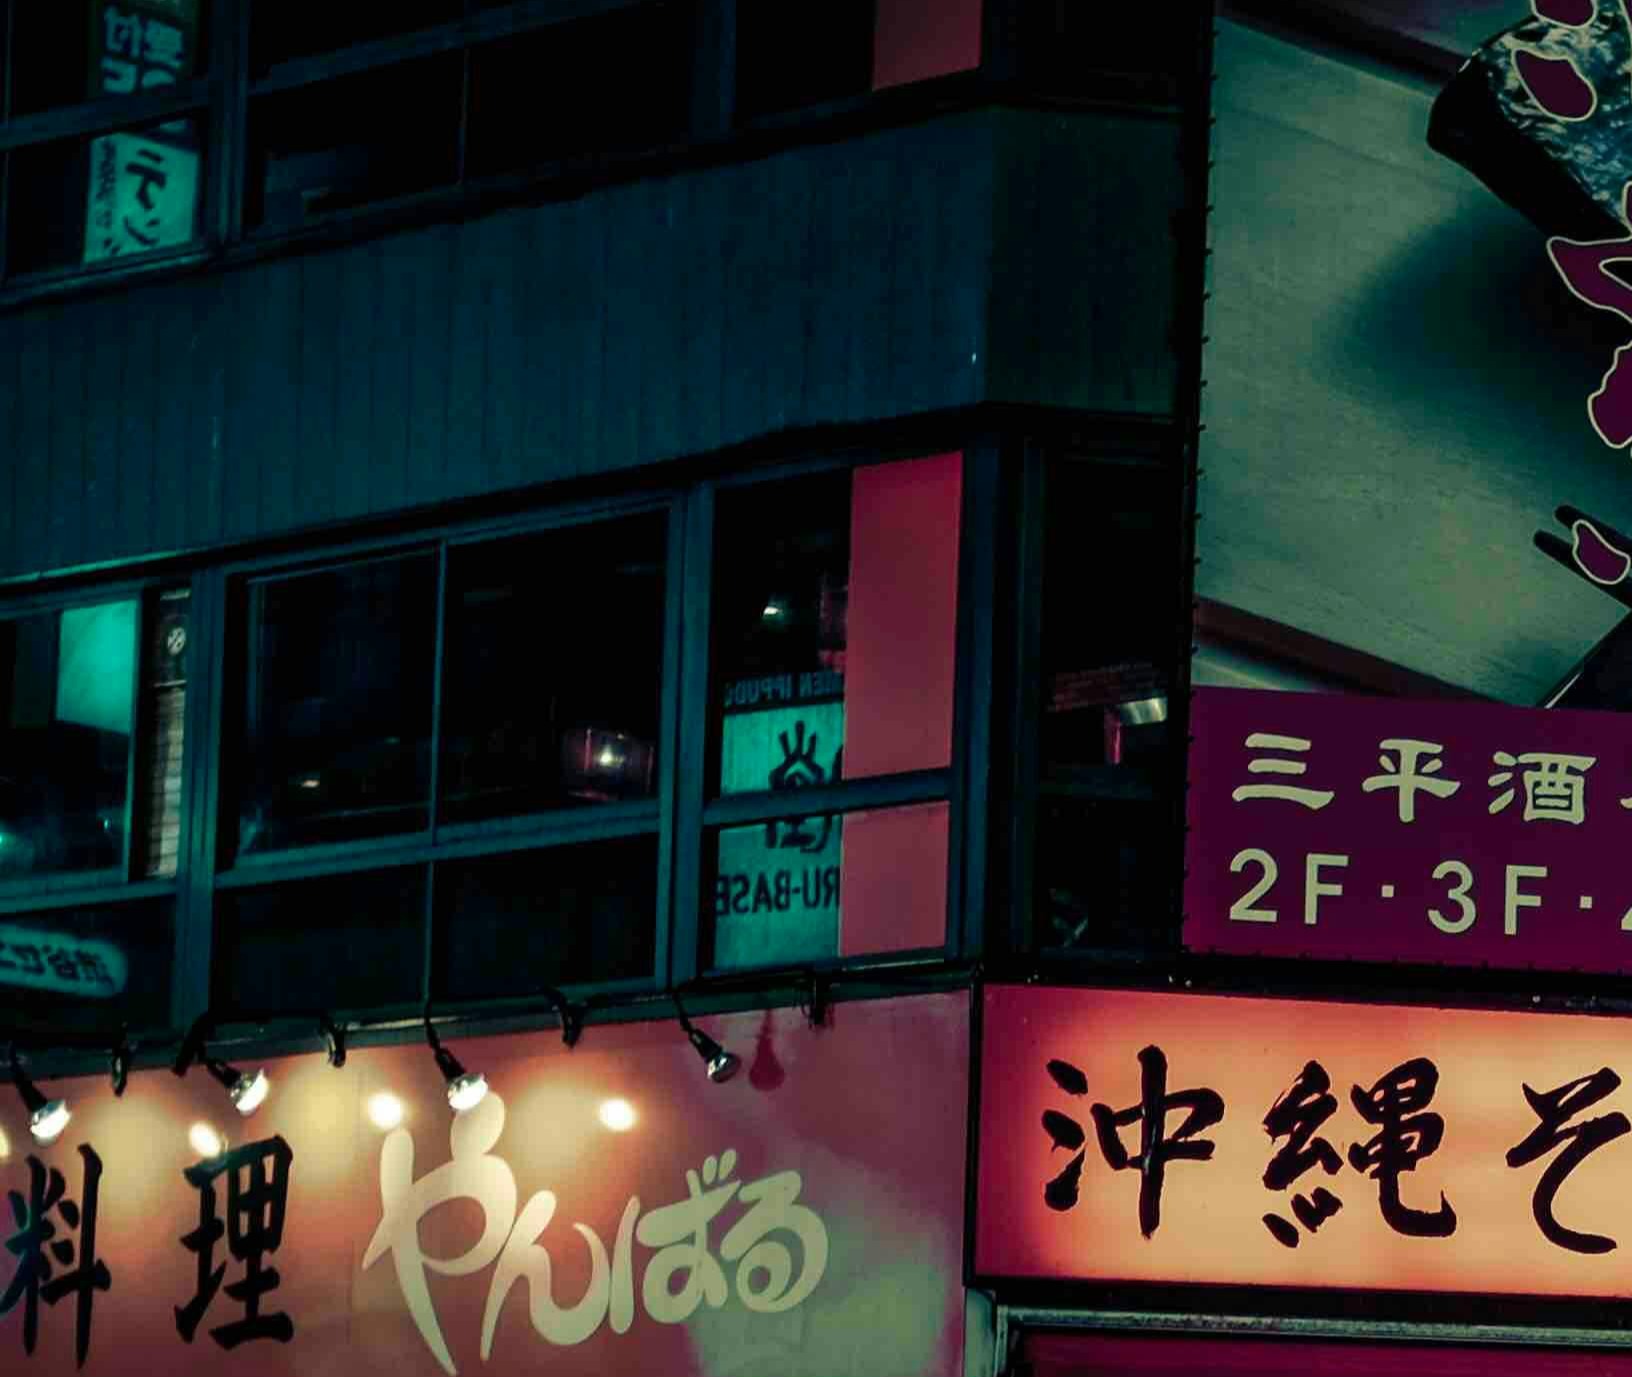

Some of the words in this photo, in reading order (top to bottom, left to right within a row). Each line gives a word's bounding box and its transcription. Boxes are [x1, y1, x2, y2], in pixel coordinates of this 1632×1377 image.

[0, 1135, 293, 1369] 料理
[362, 1092, 828, 1377] やんばる
